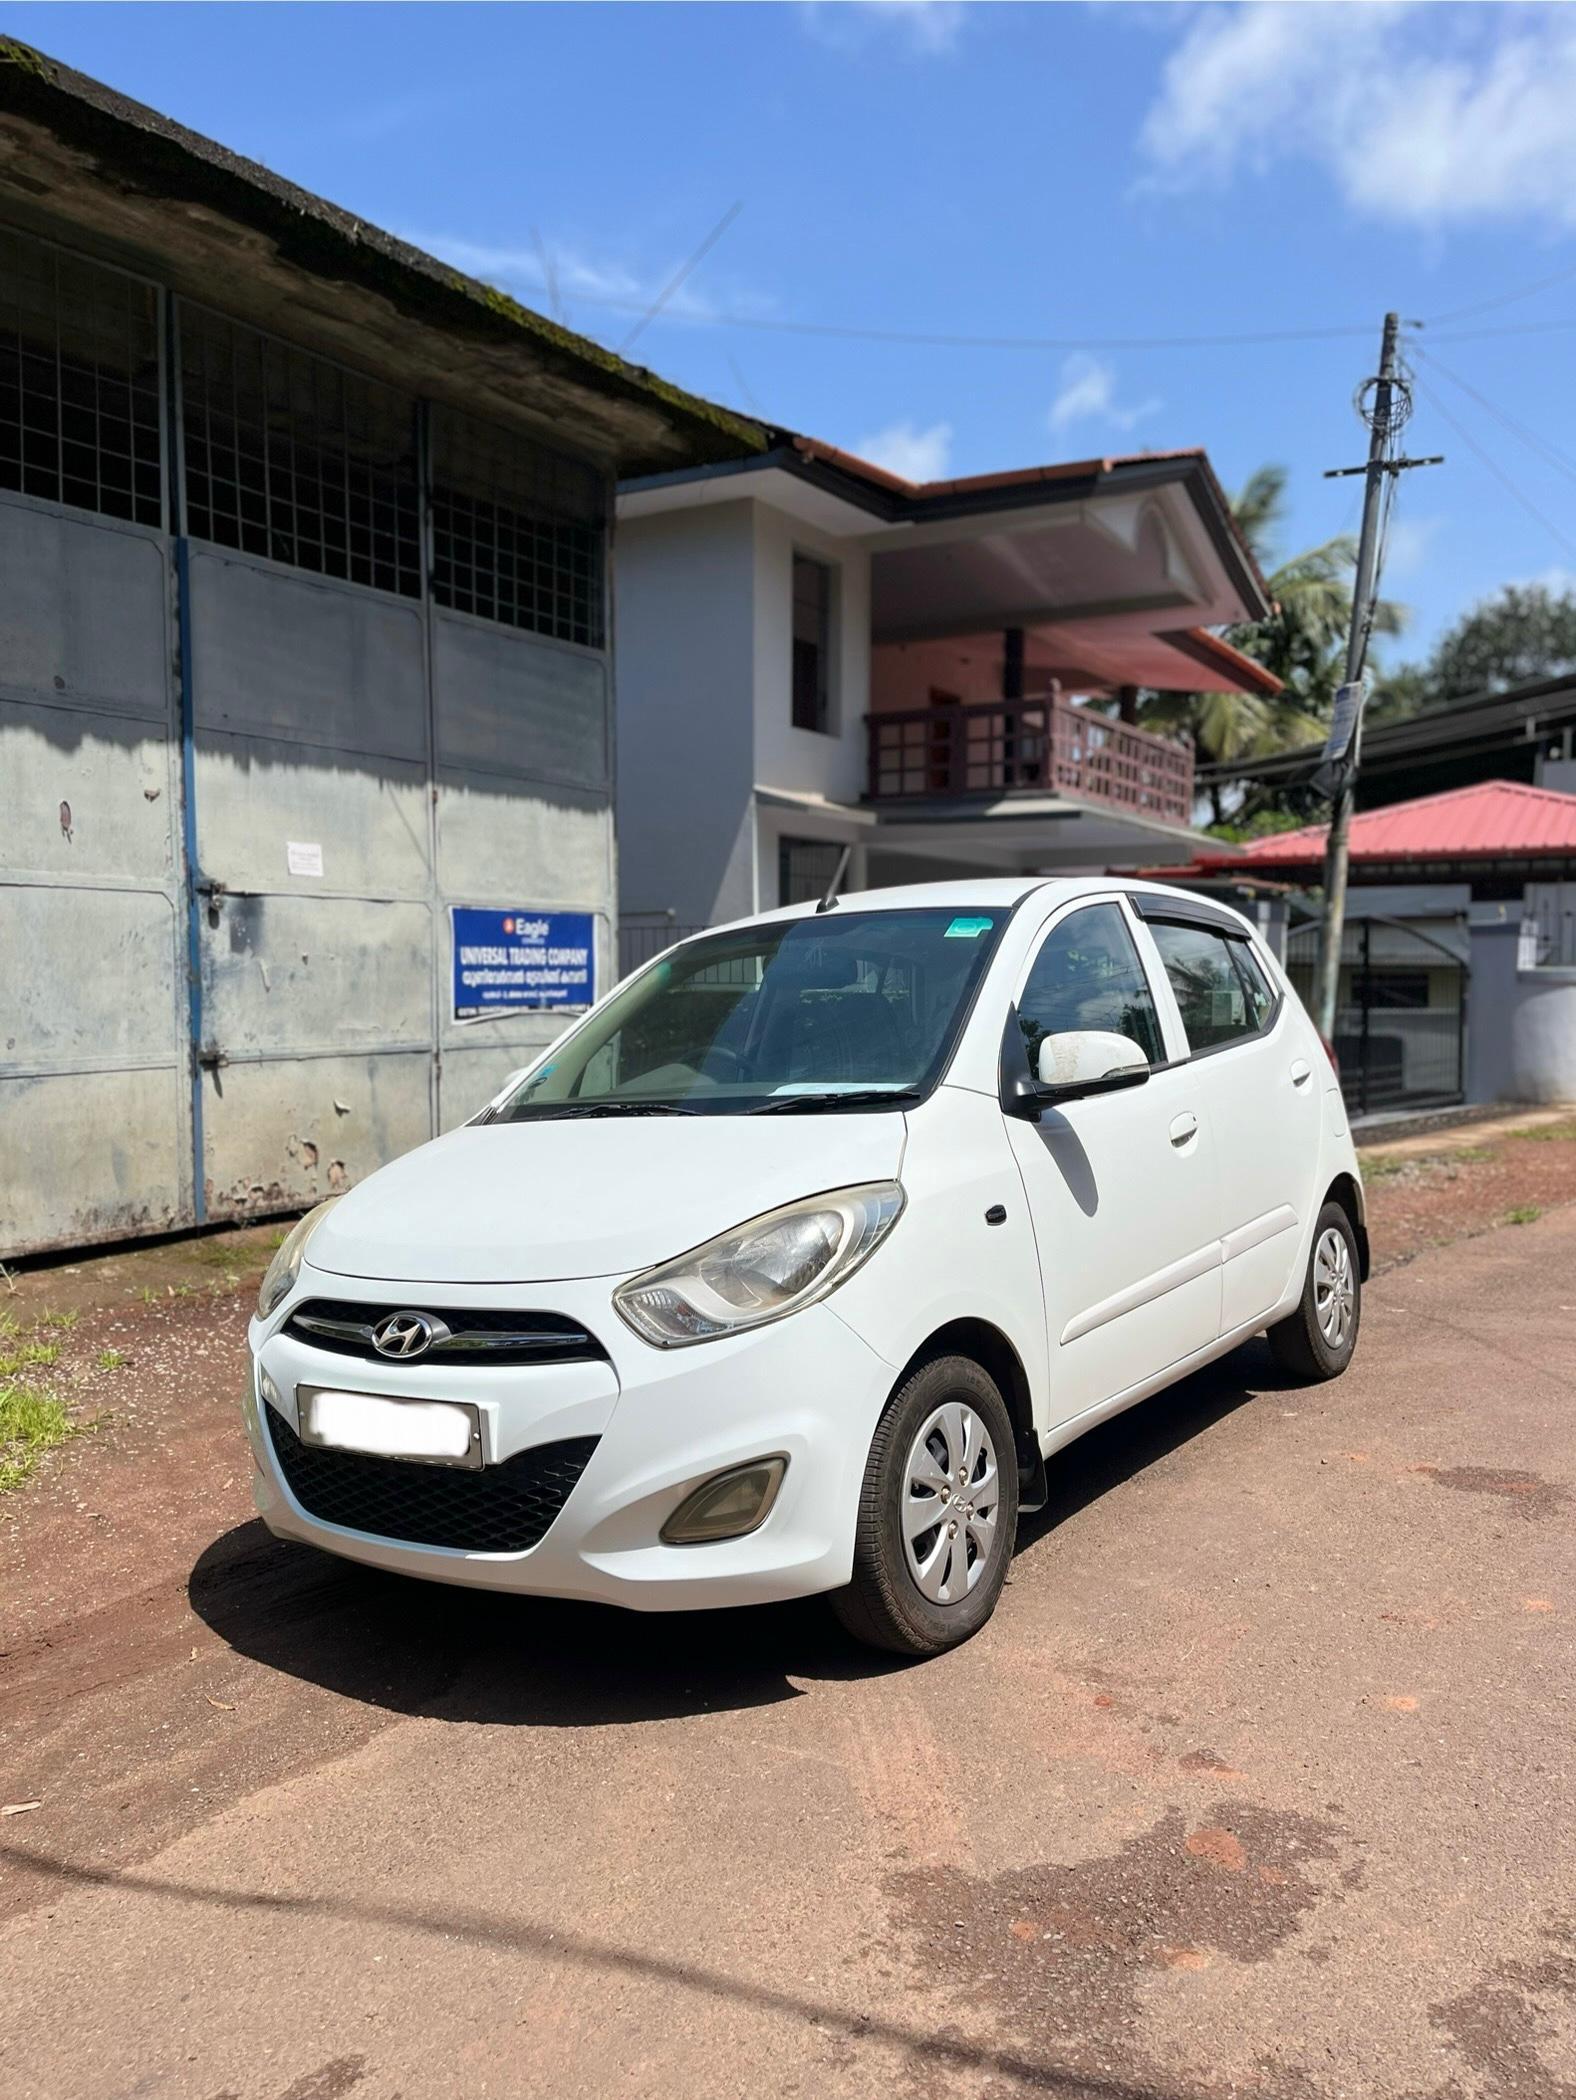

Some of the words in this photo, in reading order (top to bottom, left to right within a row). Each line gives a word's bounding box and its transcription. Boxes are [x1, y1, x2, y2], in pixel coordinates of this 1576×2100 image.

[515, 917, 550, 938] Eagle
[460, 946, 508, 965] UNIVERSAL
[509, 946, 547, 965] TRADING
[548, 947, 588, 966] COMPANY
